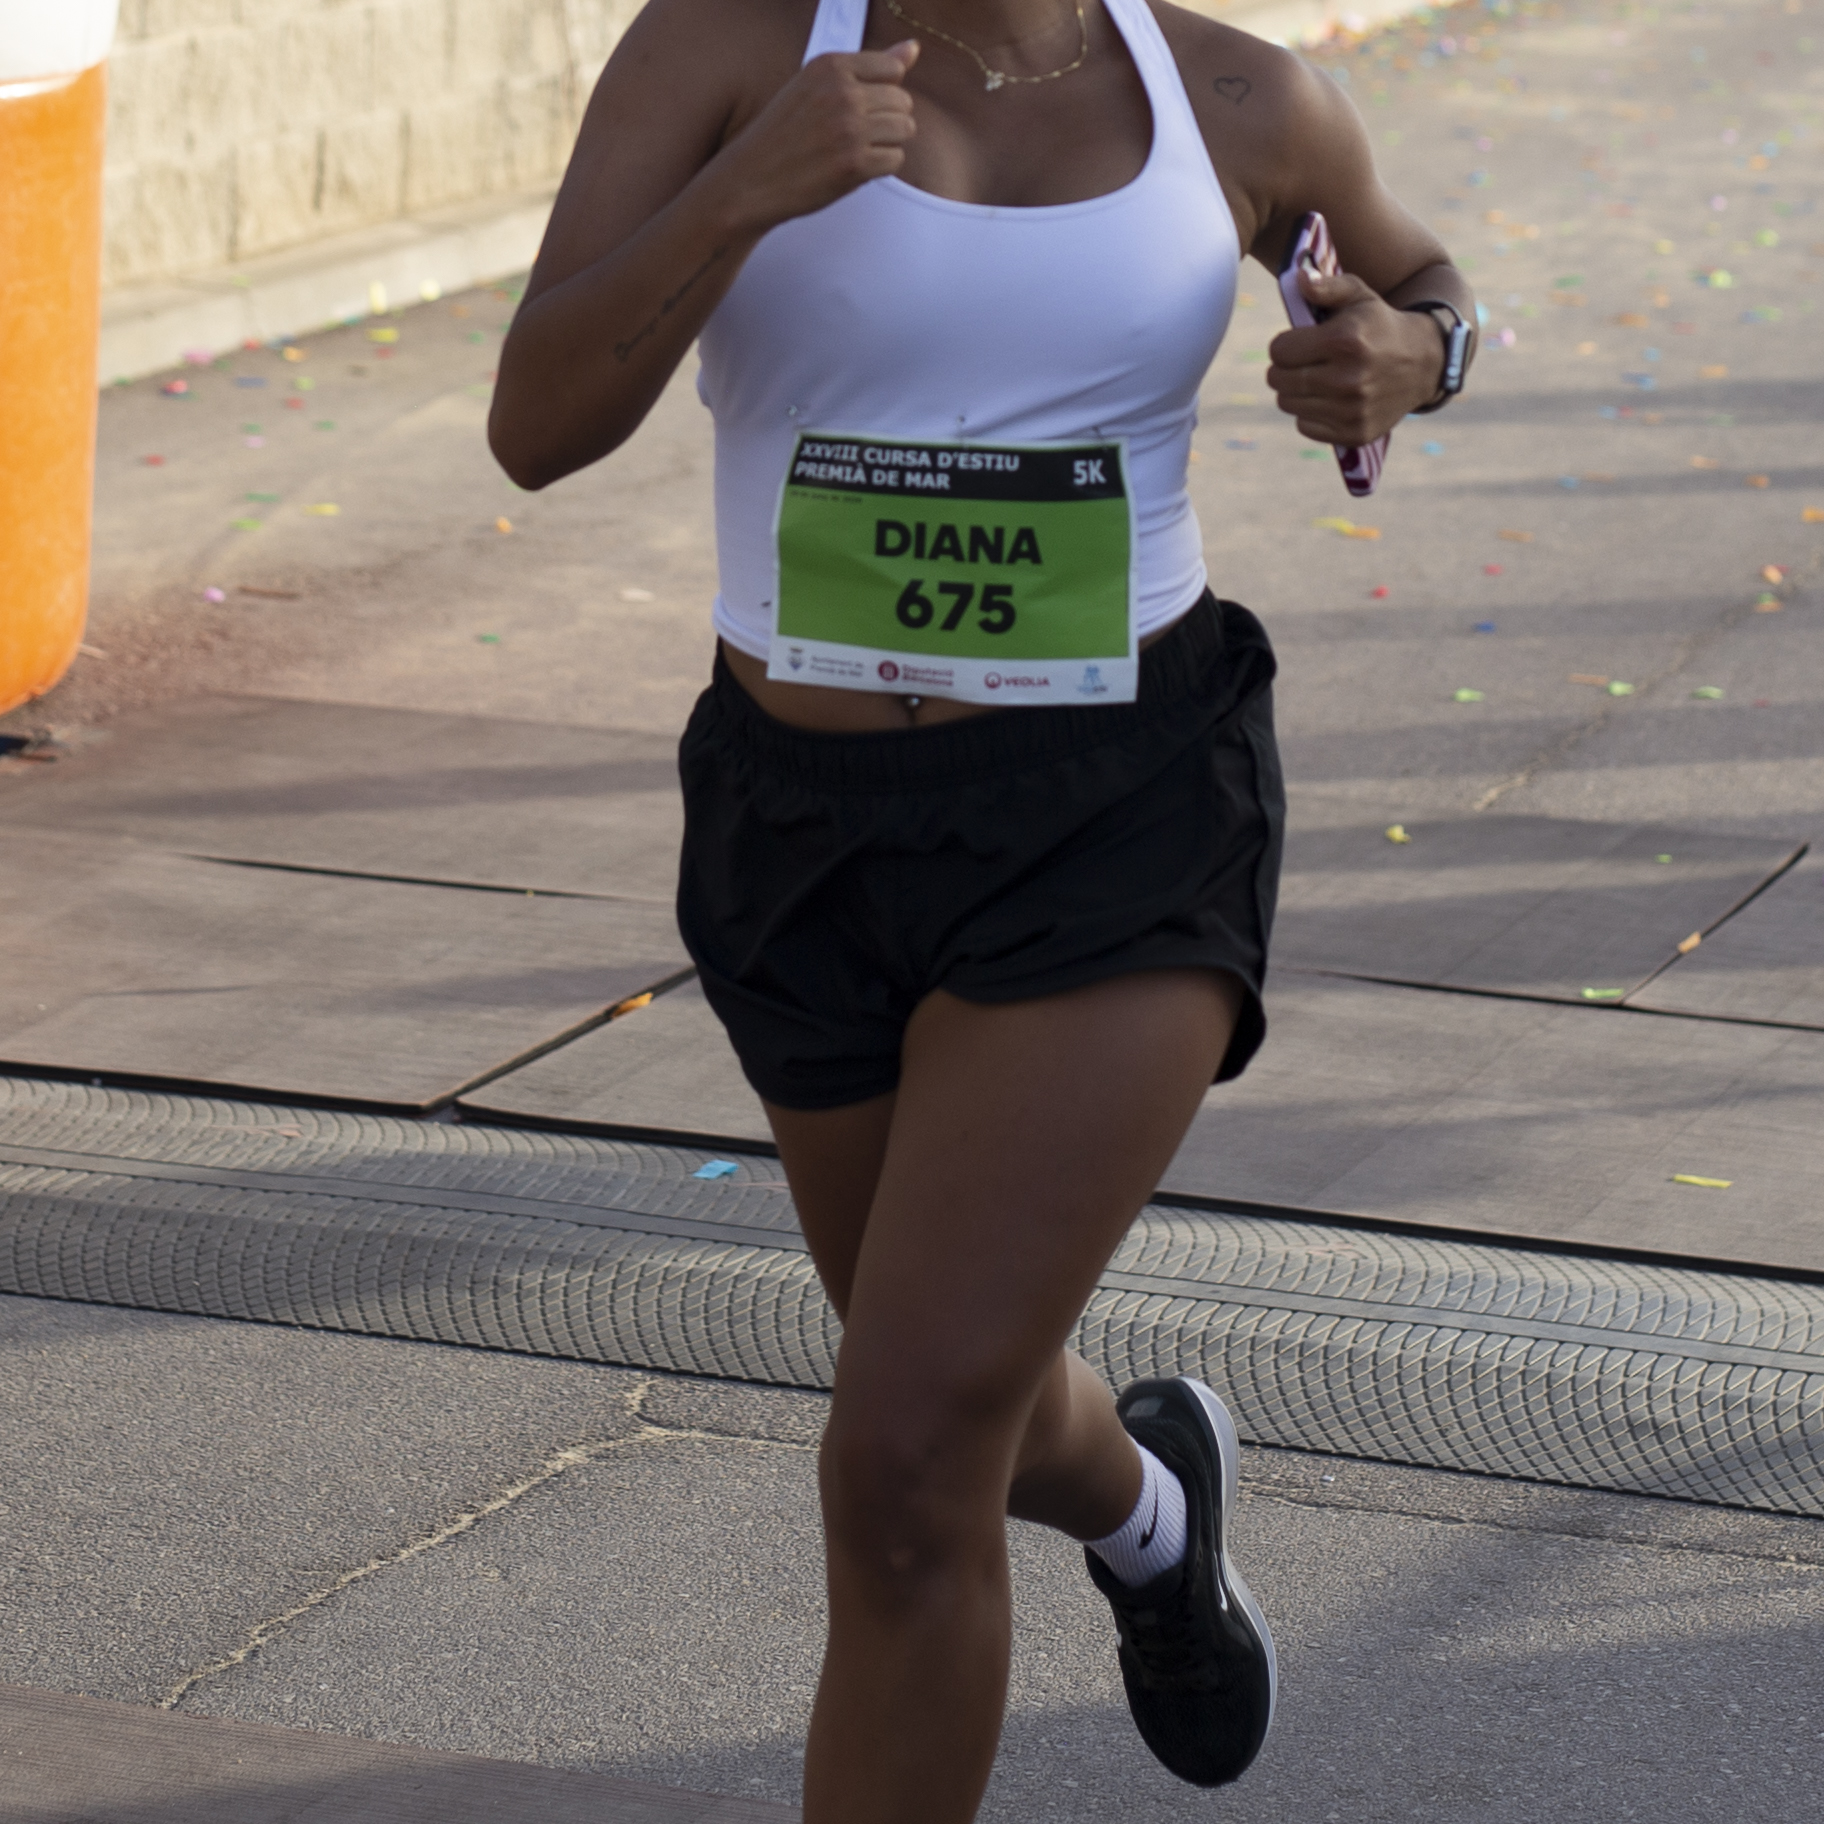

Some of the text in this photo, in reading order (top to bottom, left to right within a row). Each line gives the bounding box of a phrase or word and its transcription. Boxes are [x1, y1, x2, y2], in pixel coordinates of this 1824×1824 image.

[800, 442, 1020, 472] XXVIII CURSA D'ESTIU
[794, 461, 951, 491] PREMIÀ DE MAR
[1072, 460, 1107, 486] 5K
[874, 519, 1043, 565] DIANA
[896, 578, 1017, 634] 675
